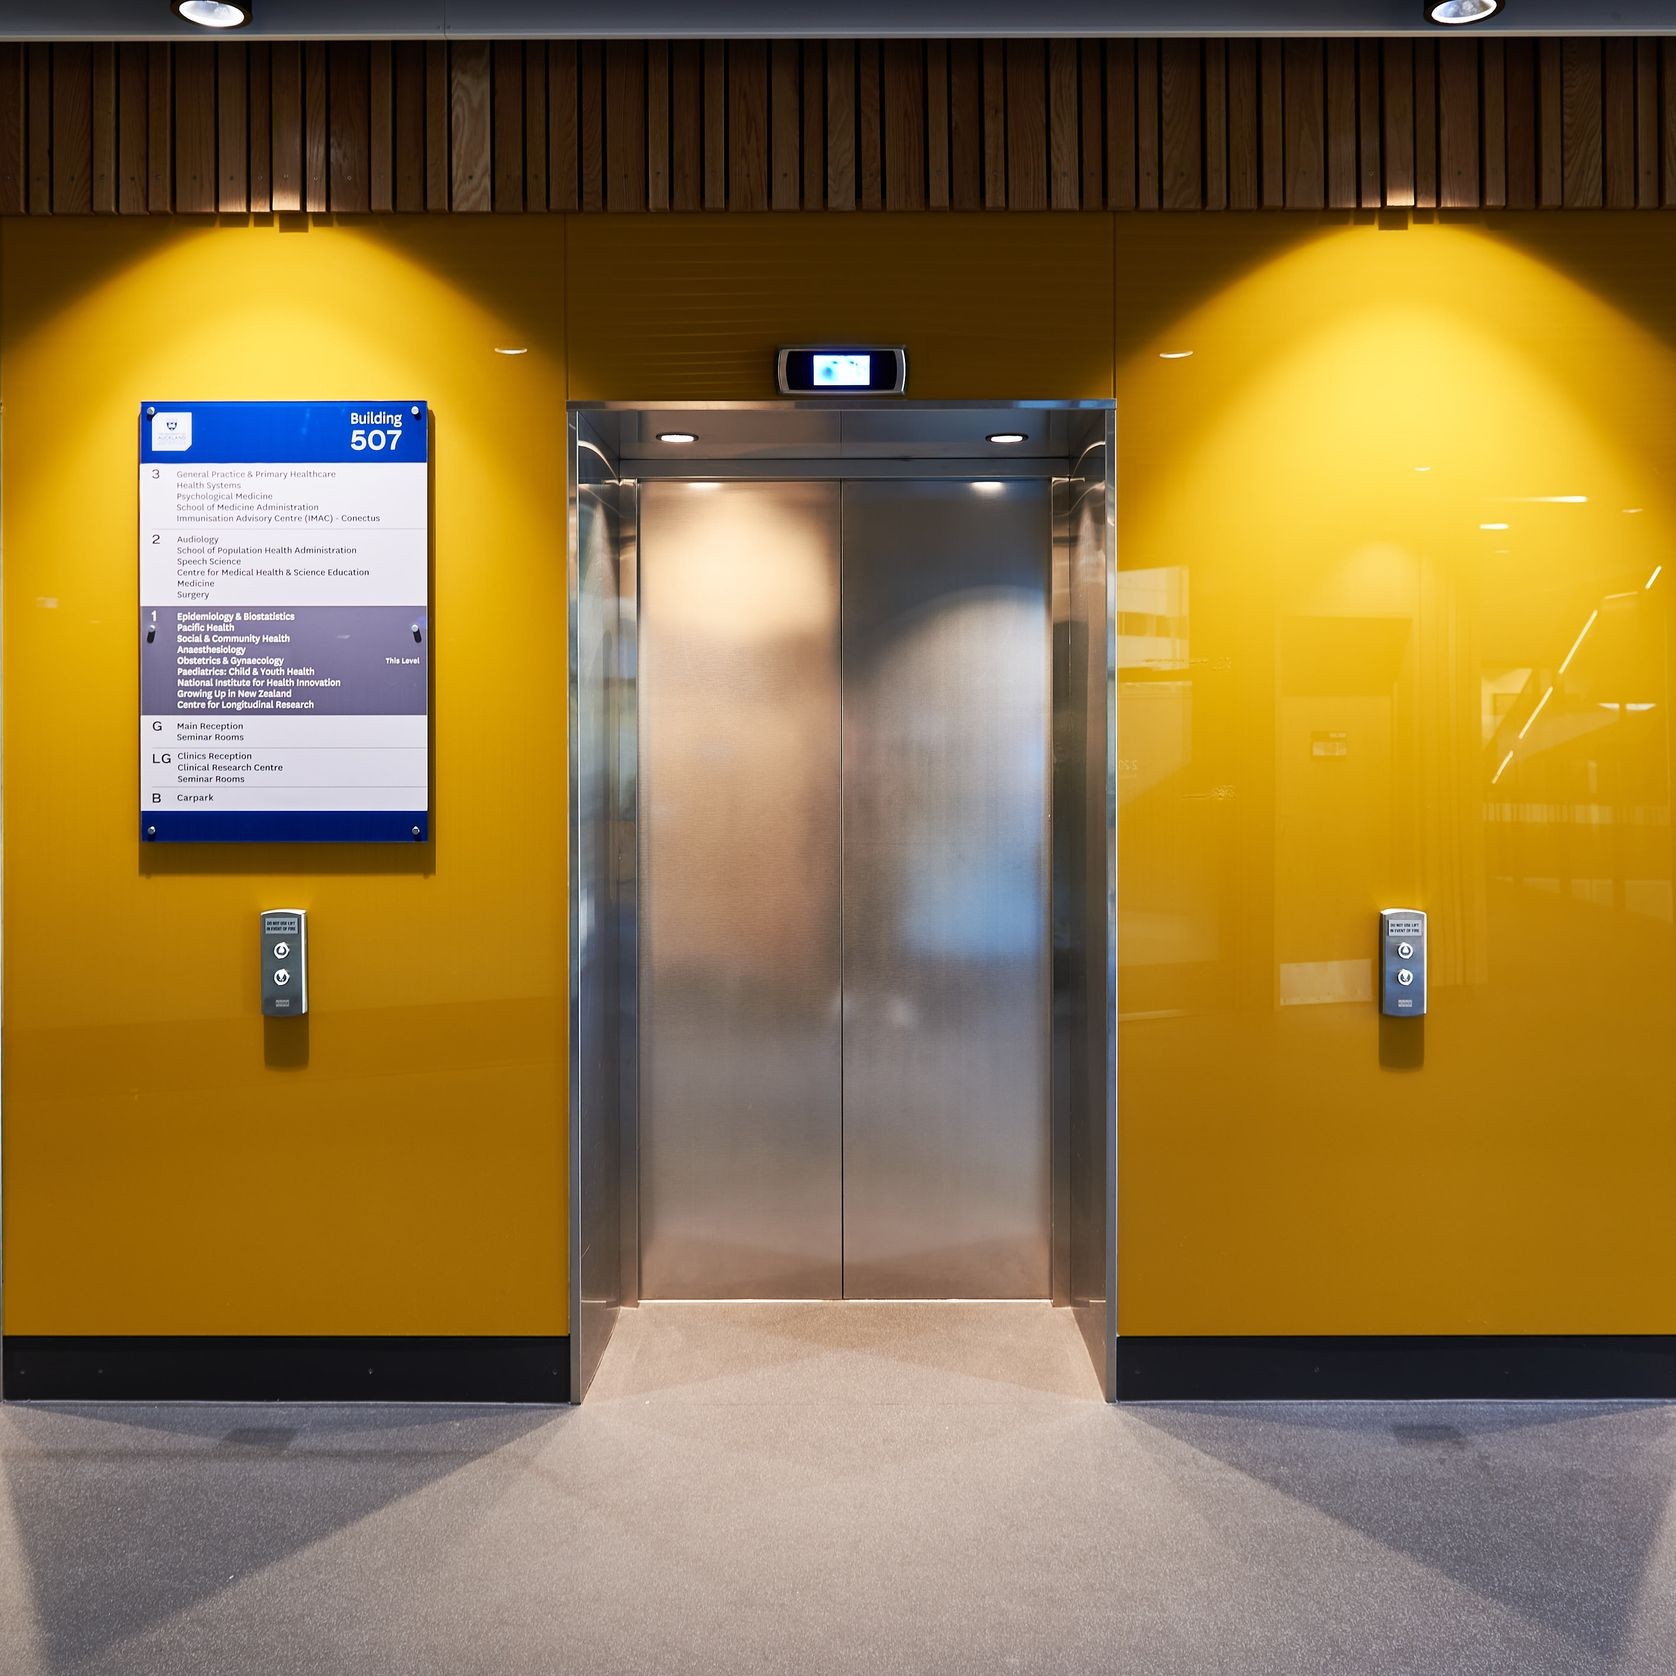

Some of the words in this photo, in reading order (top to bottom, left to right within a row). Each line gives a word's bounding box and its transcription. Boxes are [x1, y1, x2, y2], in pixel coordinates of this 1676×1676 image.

[351, 411, 402, 428] Building
[350, 429, 402, 451] 507
[152, 469, 160, 479] 3
[176, 470, 209, 478] General
[255, 470, 288, 480] Primary
[290, 470, 336, 478] Healthcare
[176, 481, 205, 489] Health
[206, 482, 241, 491] Systems
[176, 492, 233, 502] Psychological
[235, 492, 273, 500] Medicine
[206, 503, 215, 511] of
[217, 503, 255, 511] Medicine
[236, 514, 272, 524] Advisory
[304, 514, 333, 524] (IMAC)
[152, 534, 160, 544] 2
[177, 535, 219, 545] Audiology
[217, 546, 263, 556] Population
[264, 546, 292, 554] Health
[294, 546, 357, 554] Administration
[177, 557, 207, 567] Speech
[209, 557, 241, 565] Science
[207, 568, 219, 576] for
[221, 568, 254, 576] Medical
[256, 568, 284, 576] Health
[293, 568, 326, 576] Science
[327, 568, 370, 576] Education
[177, 579, 215, 587] Medicine
[177, 591, 210, 600] Surgery
[151, 610, 157, 622] 1
[177, 611, 234, 622] Epidemiology
[235, 612, 242, 621] &
[243, 611, 295, 621] Biostatistics
[177, 622, 205, 632] Pacific
[206, 623, 235, 632] Health
[177, 634, 203, 643] Social
[203, 634, 211, 643] &
[212, 633, 261, 644] Community
[262, 633, 290, 643] Health
[177, 644, 246, 655] Anaesthesiology
[177, 656, 221, 665] Obstetrics
[222, 656, 229, 665] &
[230, 655, 285, 666] Gynaecology
[177, 667, 227, 676] Paediatrics:
[228, 666, 251, 676] Child
[252, 667, 259, 676] &
[260, 666, 285, 676] Youth
[287, 666, 315, 676] Health
[177, 678, 214, 687] National
[215, 678, 251, 687] Institute
[252, 677, 265, 687] for
[266, 678, 295, 687] Health
[296, 677, 341, 687] Innovation
[177, 689, 213, 700] Growing
[214, 689, 226, 700] Up
[228, 689, 236, 698] in
[238, 689, 257, 698] New
[258, 689, 292, 698] Zealand
[177, 700, 206, 709] Centre
[207, 700, 220, 709] for
[221, 700, 274, 711] Longitudinal
[275, 700, 314, 709] Research
[152, 721, 162, 731] G
[200, 722, 244, 732] Reception
[177, 733, 212, 741] Seminar
[152, 753, 171, 764] LG
[177, 752, 206, 760] Clinics
[208, 752, 252, 762] Reception
[177, 763, 210, 771] Clinical
[212, 763, 252, 771] Research
[253, 764, 283, 772] Centre
[177, 775, 213, 783] Seminar
[152, 793, 161, 803] B
[177, 793, 214, 803] Carpark
